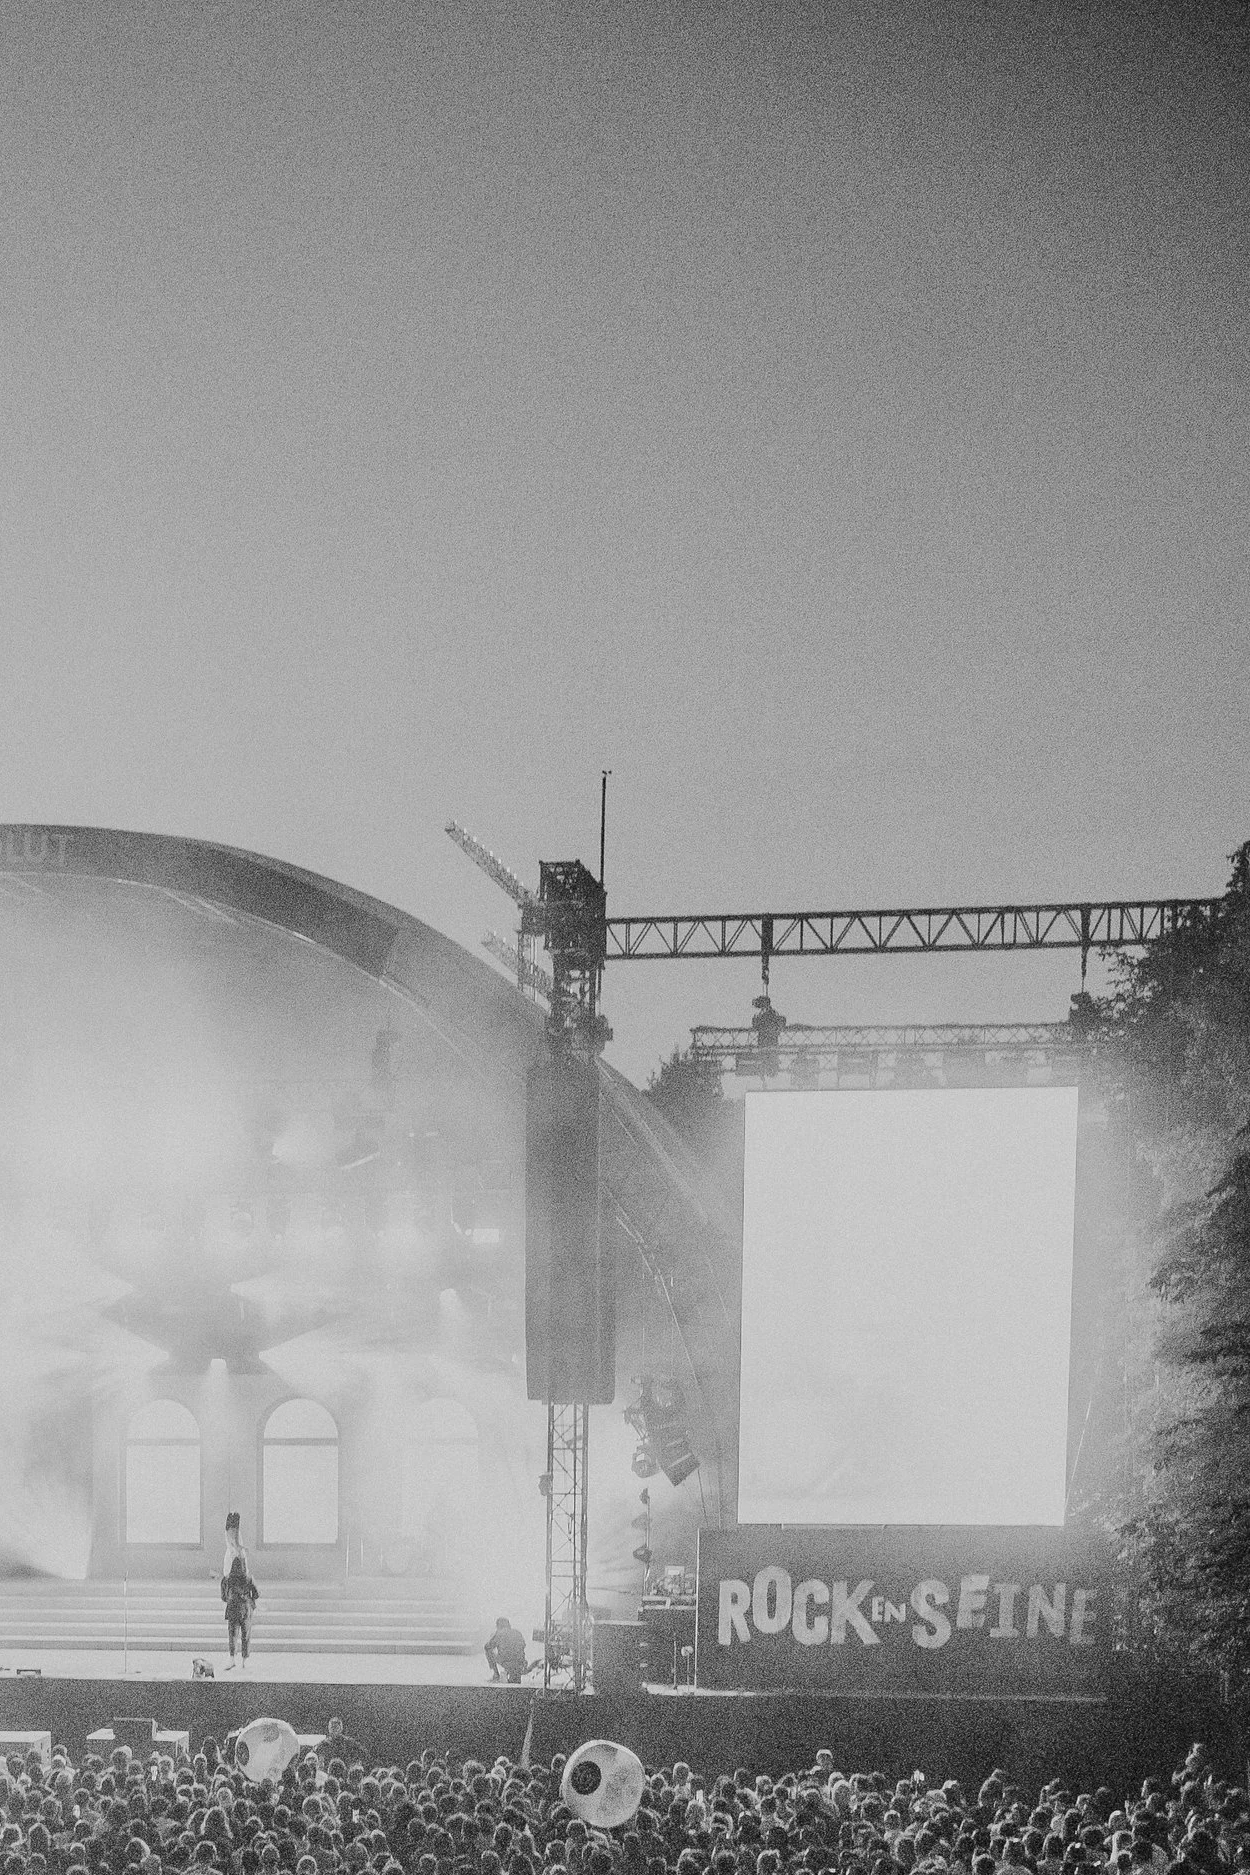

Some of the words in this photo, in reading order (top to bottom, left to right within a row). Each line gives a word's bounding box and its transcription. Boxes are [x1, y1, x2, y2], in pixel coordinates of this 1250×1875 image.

[717, 1566, 881, 1646] ROCK
[871, 1597, 907, 1624] EN
[910, 1574, 1099, 1650] SEINE
